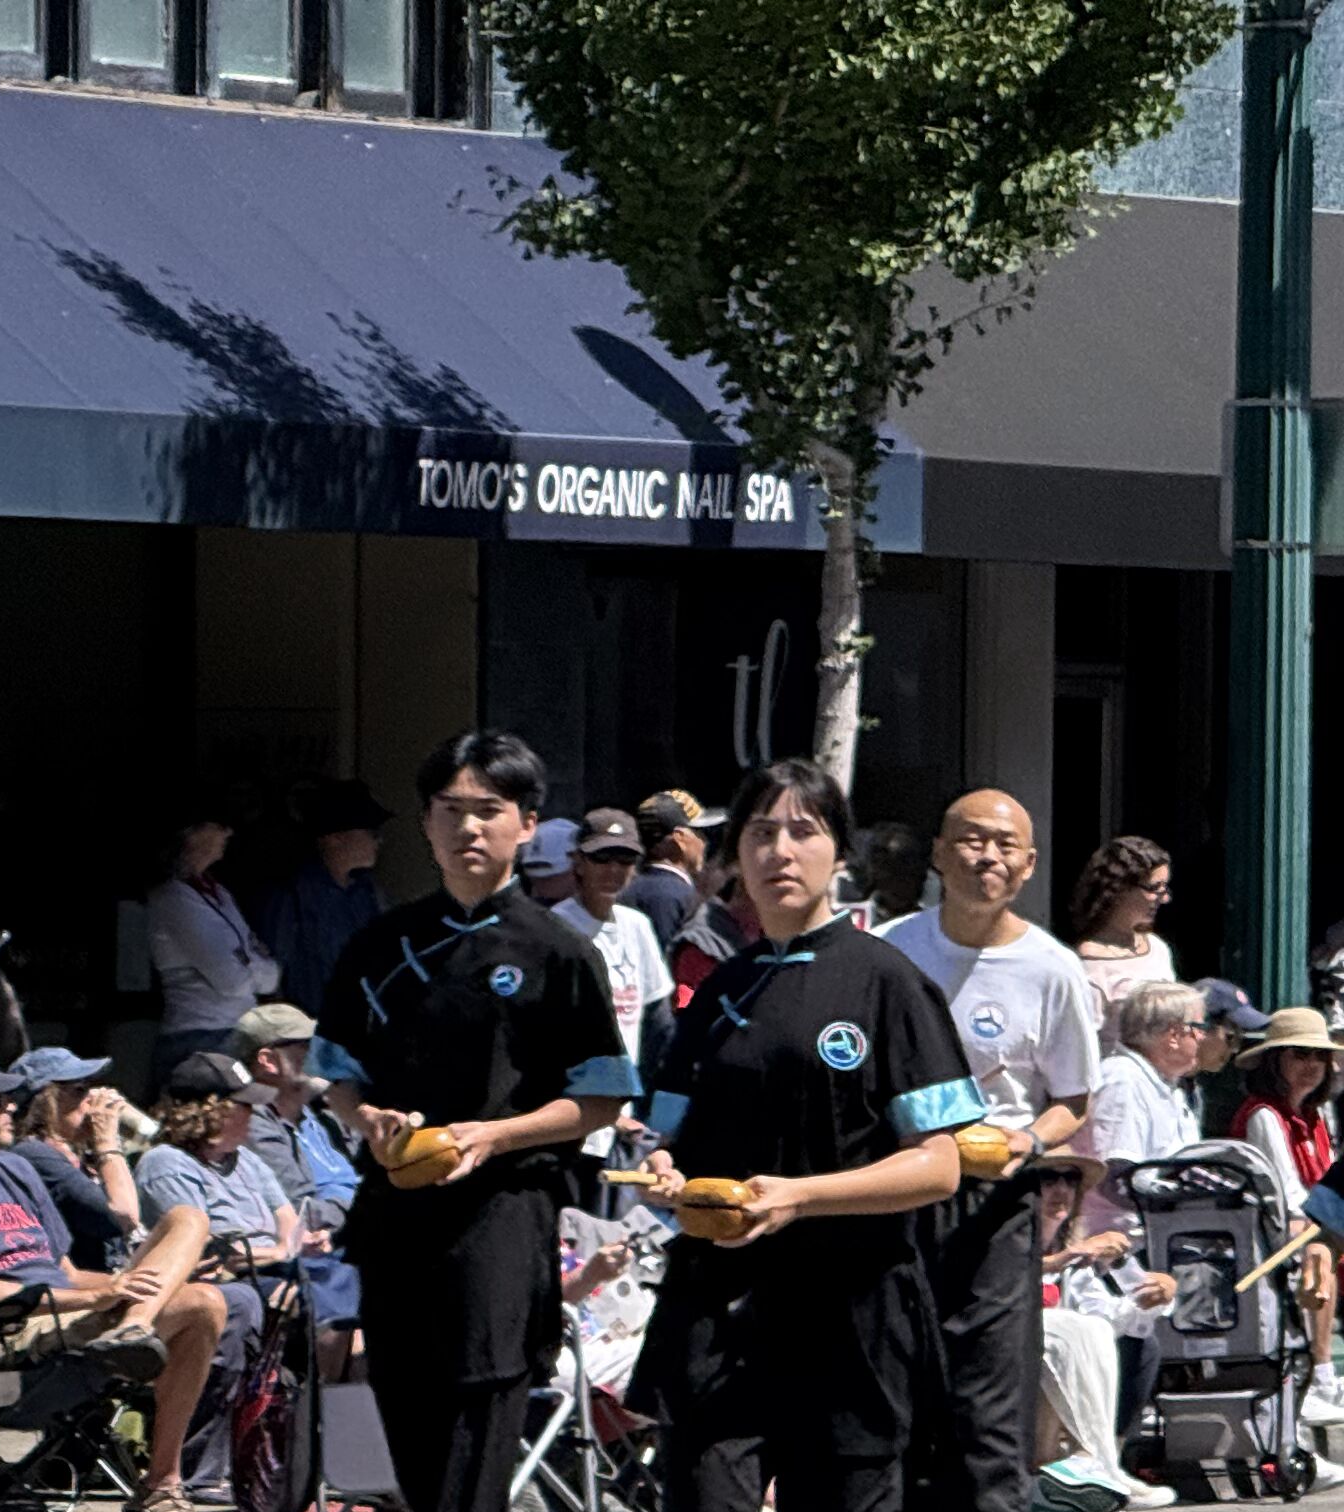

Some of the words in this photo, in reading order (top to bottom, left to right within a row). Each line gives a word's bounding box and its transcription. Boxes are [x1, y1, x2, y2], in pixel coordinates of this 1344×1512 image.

[417, 459, 528, 512] TOMO'S
[537, 463, 668, 519] ORGANIC
[677, 473, 733, 520] NAIL
[745, 473, 795, 522] SPA
